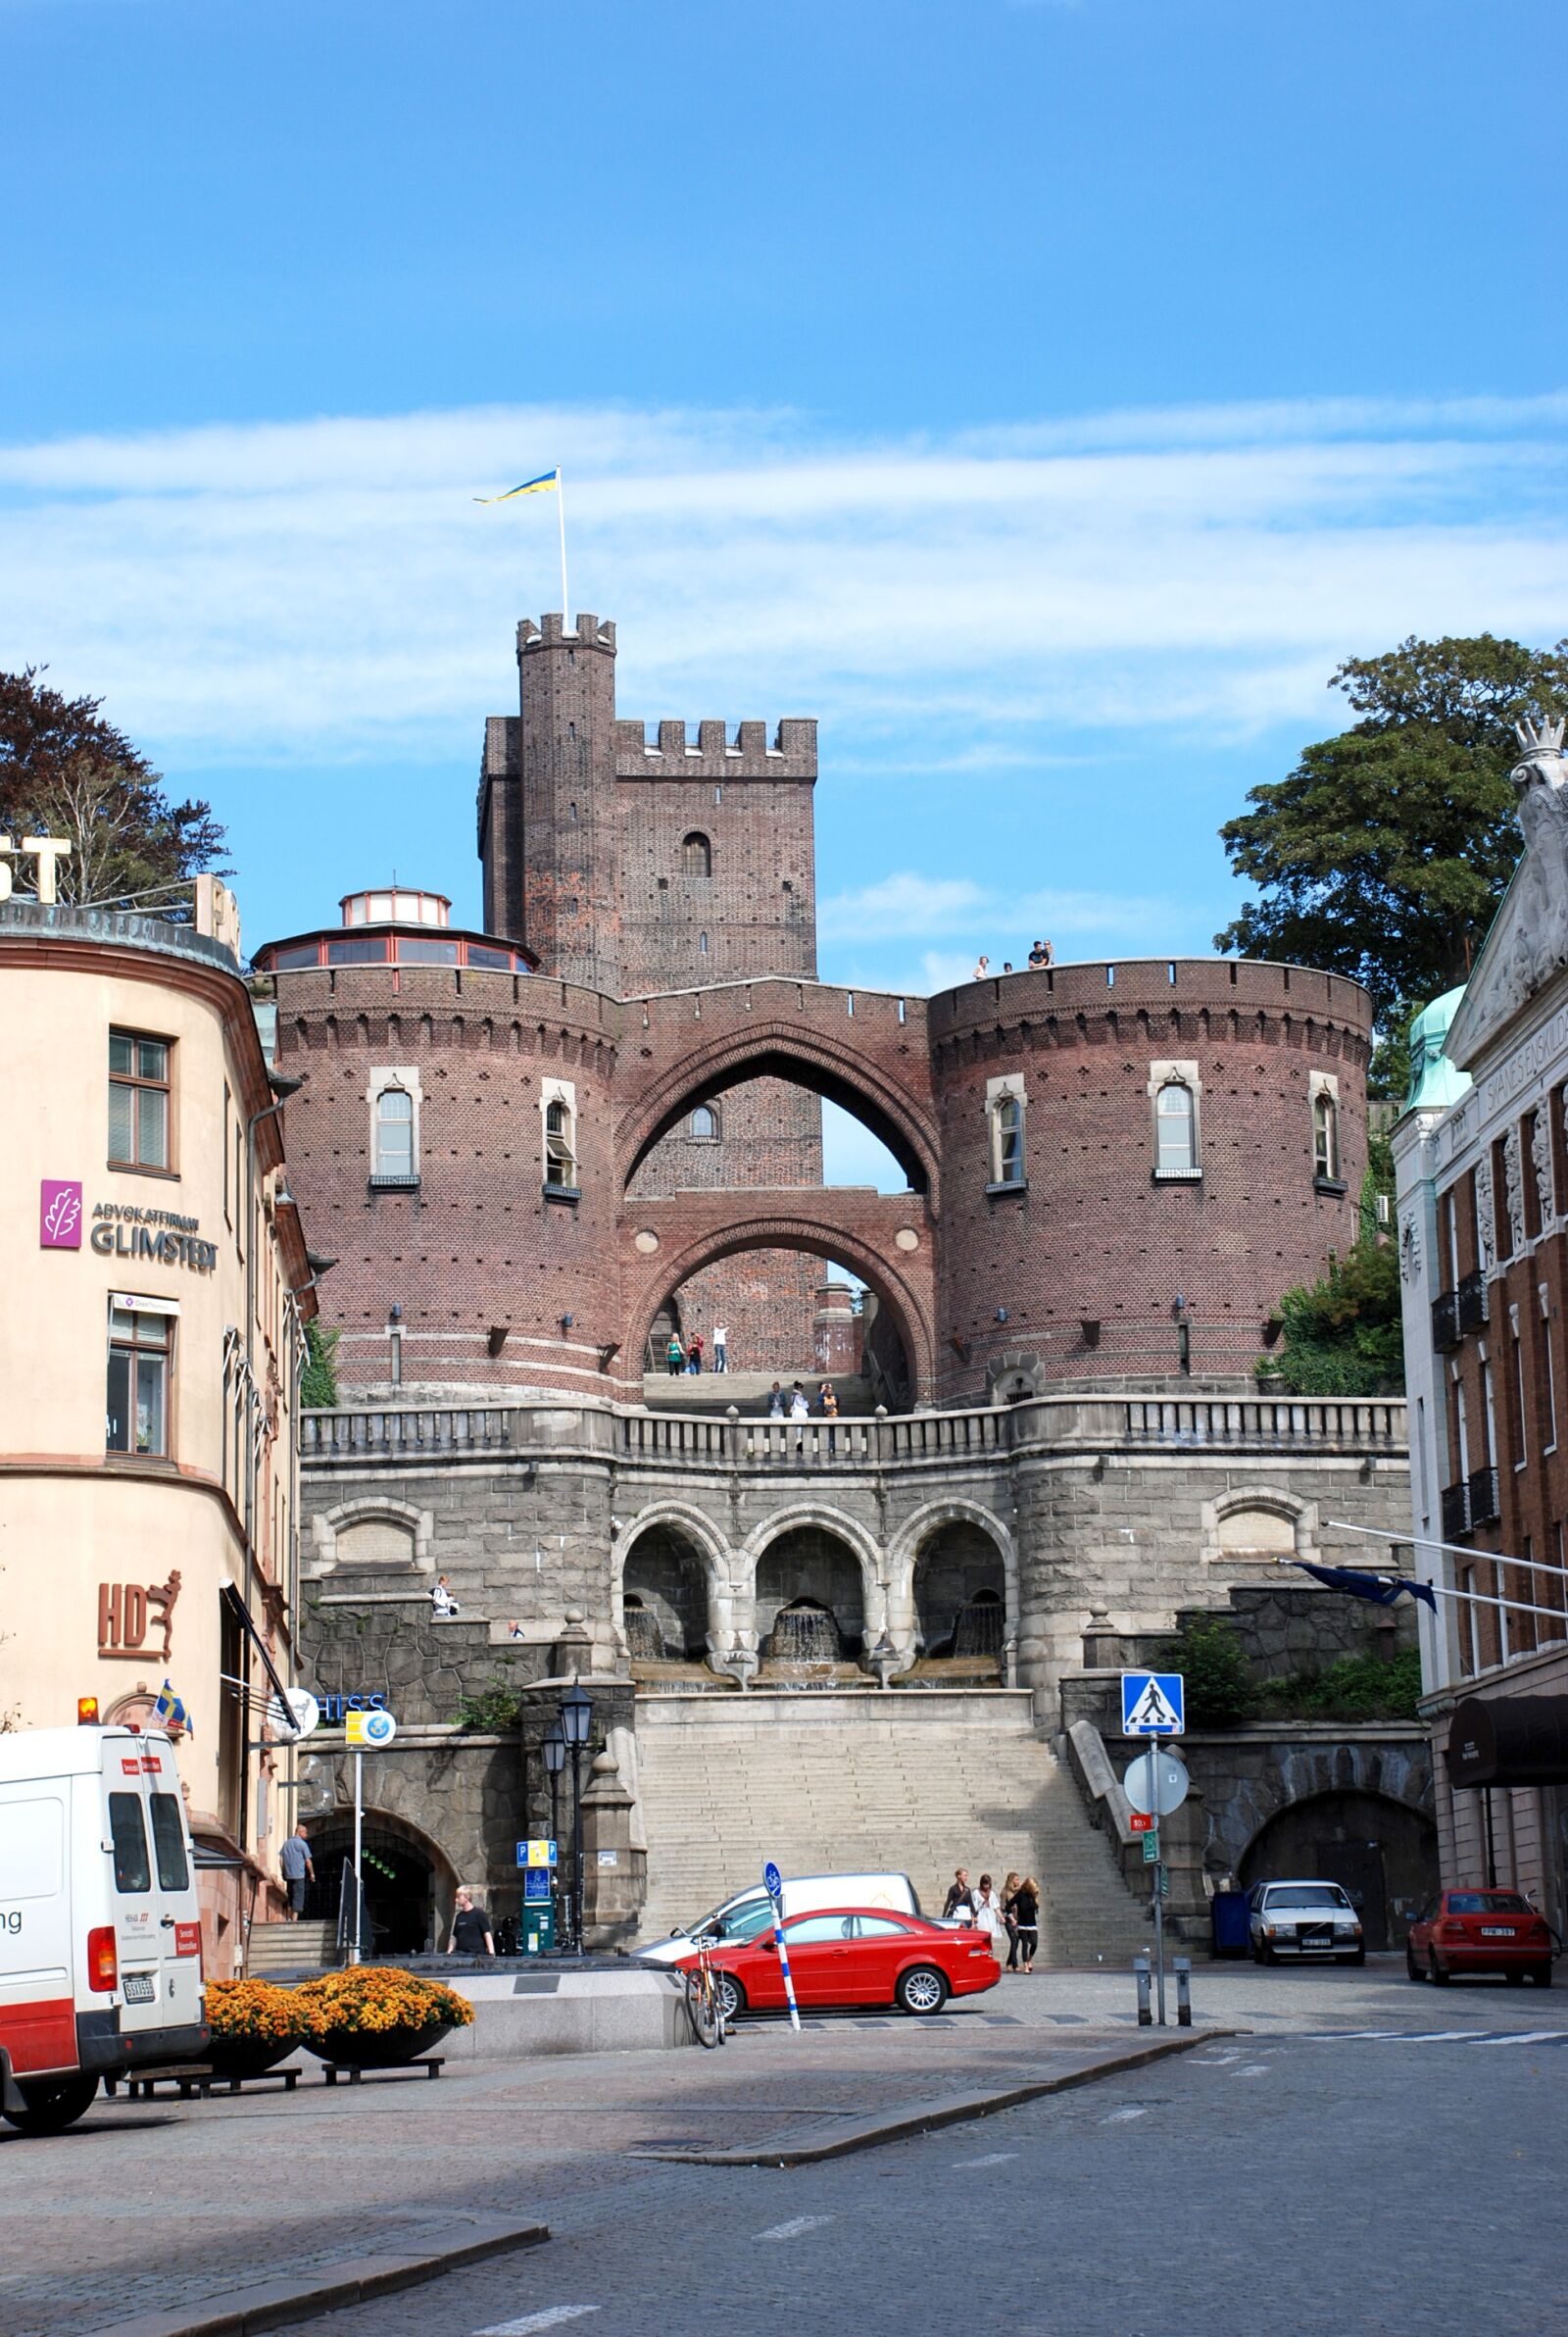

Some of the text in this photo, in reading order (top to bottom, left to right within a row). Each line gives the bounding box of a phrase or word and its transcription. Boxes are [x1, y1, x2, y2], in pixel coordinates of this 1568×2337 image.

[92, 1202, 199, 1232] ADVOKATFIRMAN
[91, 1222, 218, 1272] GLIMSTEDT
[98, 1583, 146, 1647] HD
[315, 1694, 387, 1720] HISS
